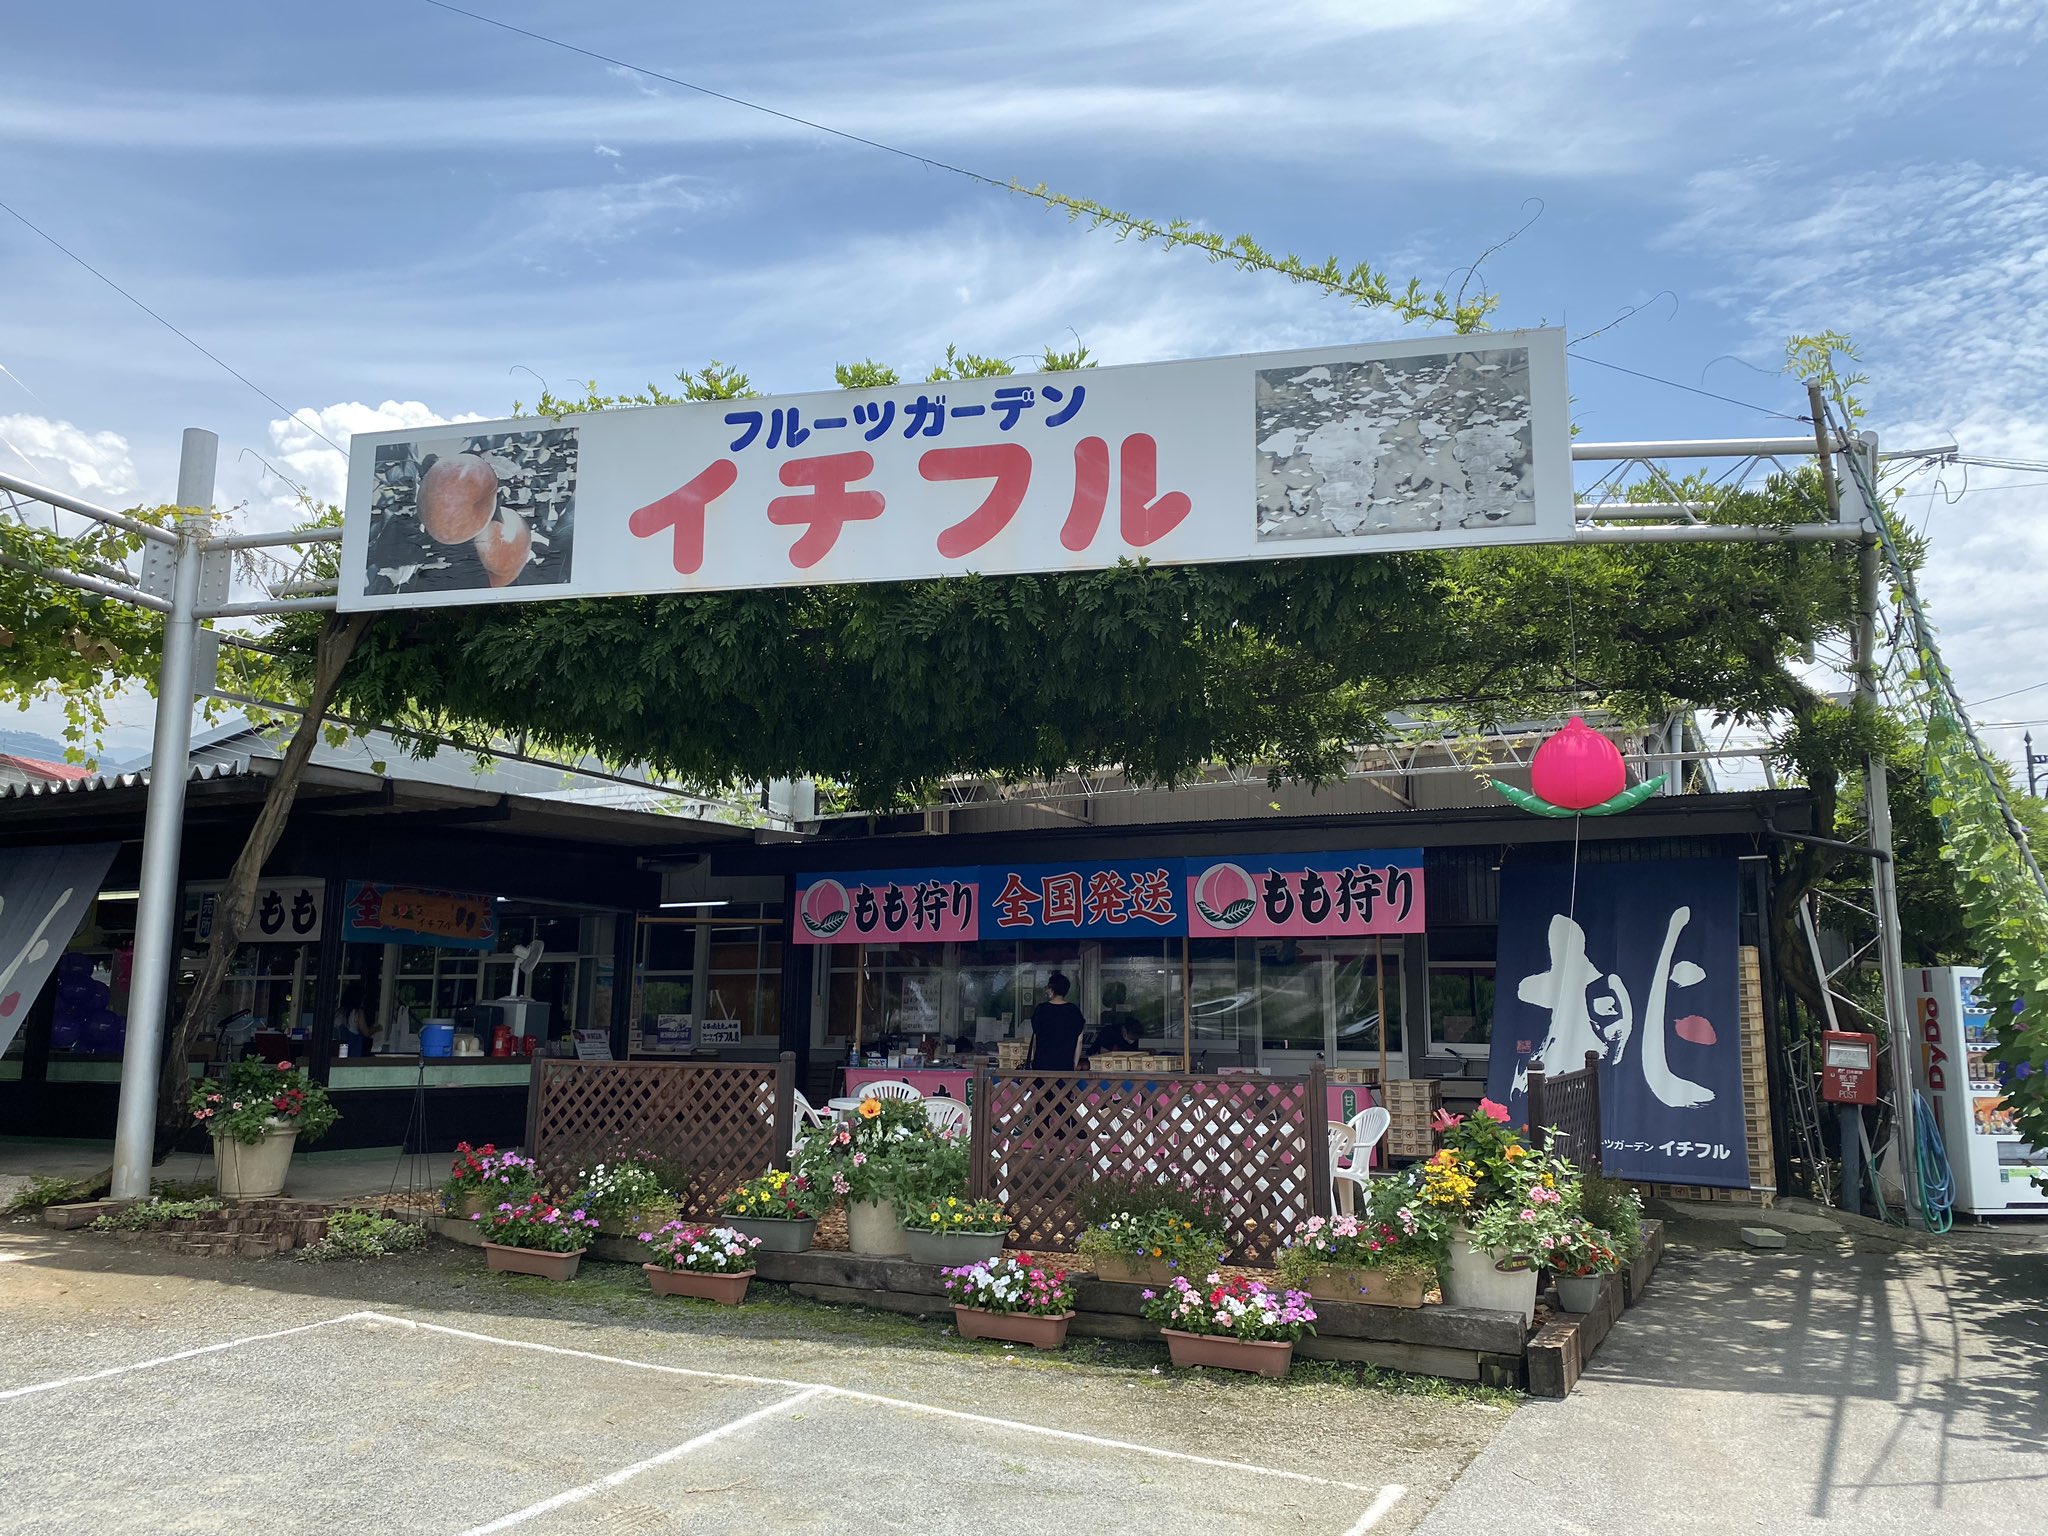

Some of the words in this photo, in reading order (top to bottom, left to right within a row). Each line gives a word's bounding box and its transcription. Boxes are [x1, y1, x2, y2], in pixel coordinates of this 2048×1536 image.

[724, 385, 1086, 452] フルーツガーデン
[628, 432, 1192, 574] イチフル
[260, 889, 316, 935] もも
[853, 879, 974, 933] もも狩り
[992, 868, 1178, 928] 全国発送
[1261, 864, 1414, 926] もも狩り
[1839, 1090, 1857, 1099] POST
[1658, 1140, 1731, 1160] イチフル
